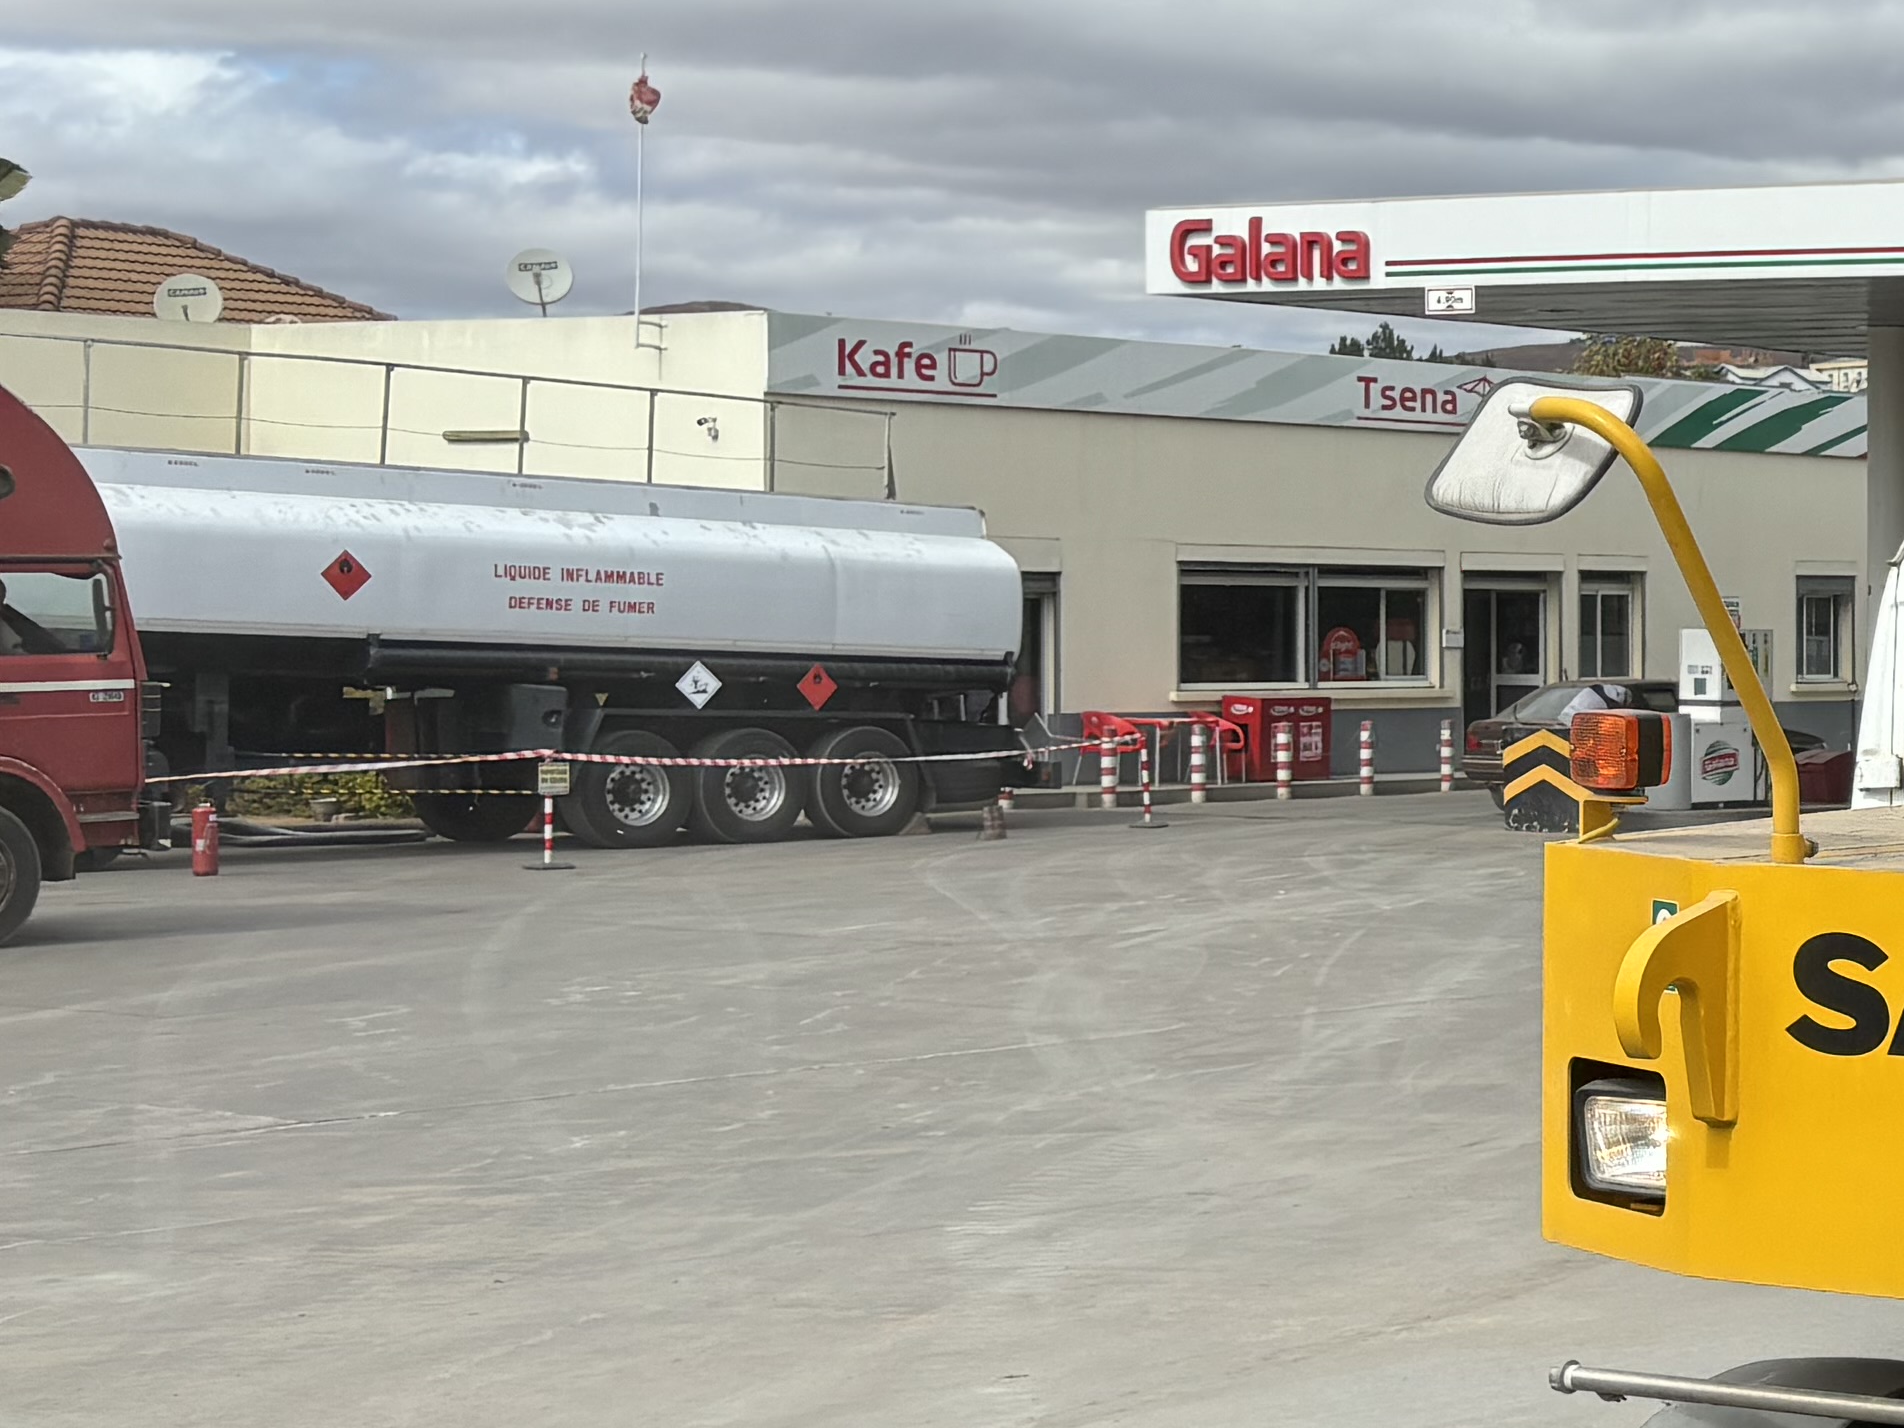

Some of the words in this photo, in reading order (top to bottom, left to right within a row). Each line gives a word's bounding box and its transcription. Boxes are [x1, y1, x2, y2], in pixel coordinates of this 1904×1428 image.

[1170, 216, 1371, 284] Galana
[837, 337, 938, 382] Kafe
[1356, 375, 1458, 415] Tsena
[494, 563, 551, 581] LIQUIDE
[560, 567, 665, 586] INFLAMMABLE
[582, 598, 600, 613] DE
[609, 600, 656, 615] FUMER
